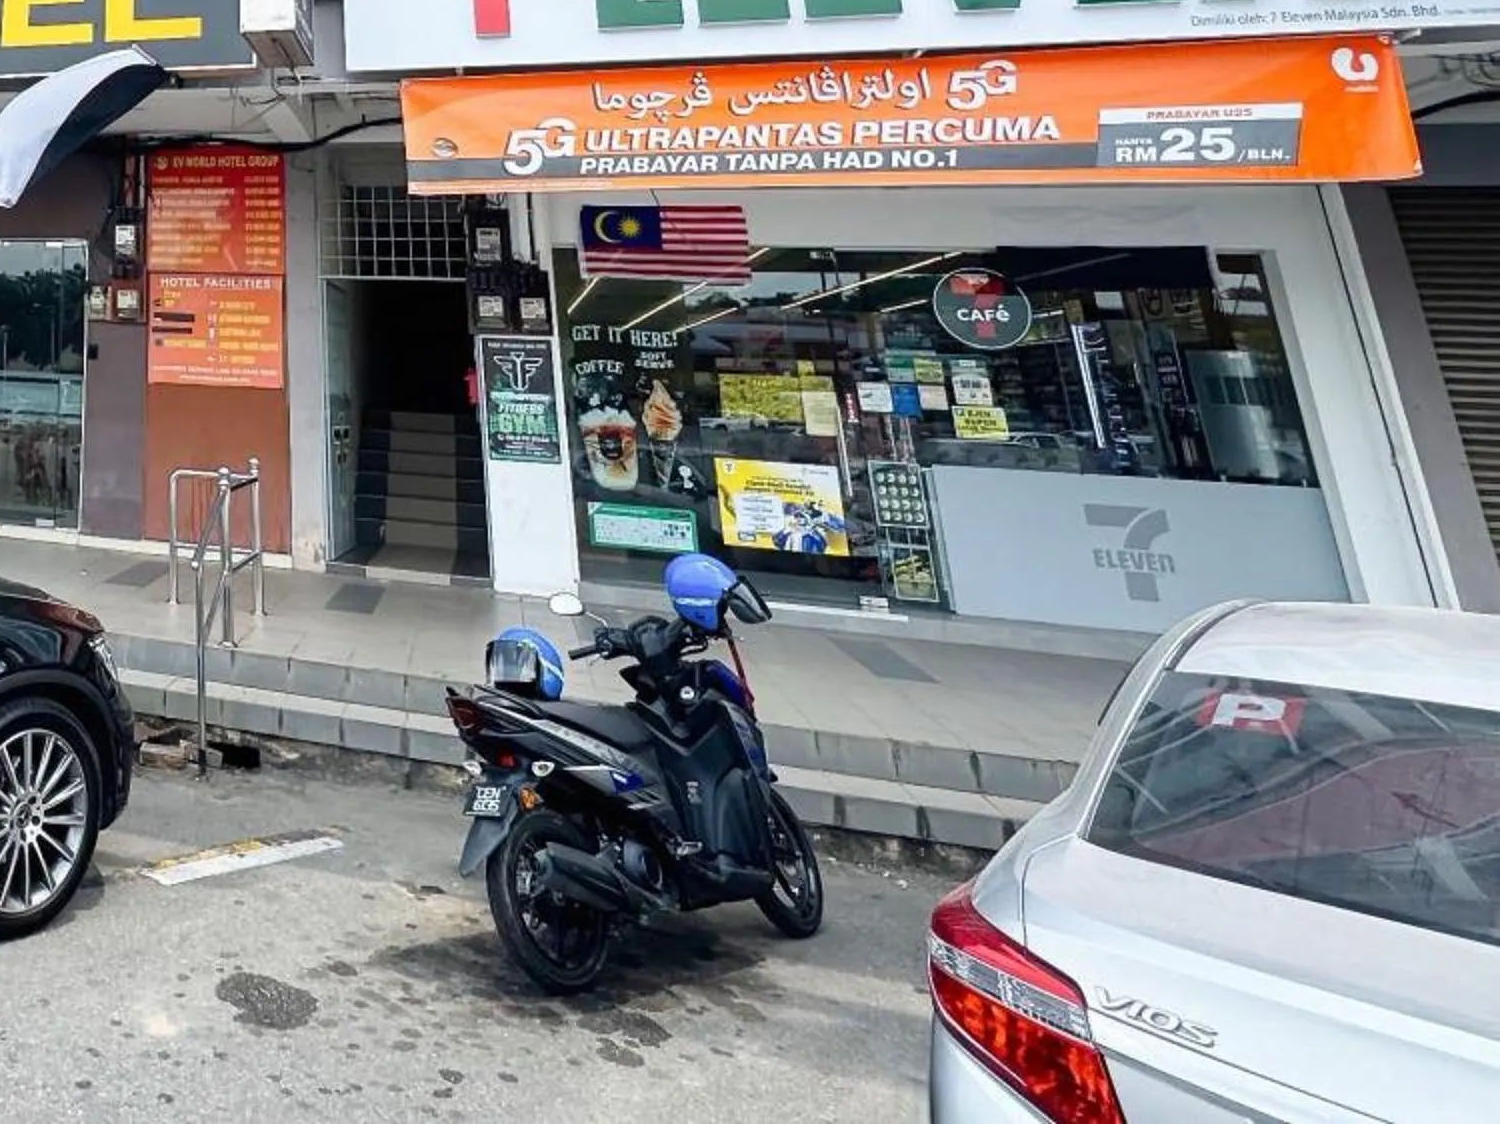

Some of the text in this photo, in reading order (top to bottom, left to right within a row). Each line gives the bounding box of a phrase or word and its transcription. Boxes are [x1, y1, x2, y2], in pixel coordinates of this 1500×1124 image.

[1281, 9, 1323, 23] Eleven
[1325, 7, 1379, 23] Malaysia
[947, 59, 1019, 112] 5G
[503, 115, 1060, 175] 5G ULTRAPANTAS PERCUMA
[186, 156, 217, 167] WORLD
[218, 156, 246, 167] HOTEL
[580, 149, 958, 175] PRABAYAR TANPA HAD NO.1
[160, 277, 271, 289] HOTEL FACILITIES
[572, 324, 679, 349] GET IT HERE!
[575, 359, 625, 375] COFFEE
[498, 403, 546, 414] FITNESS
[499, 414, 546, 434] GYM
[1212, 693, 1286, 726] P
[1094, 985, 1219, 1049] VIOS
